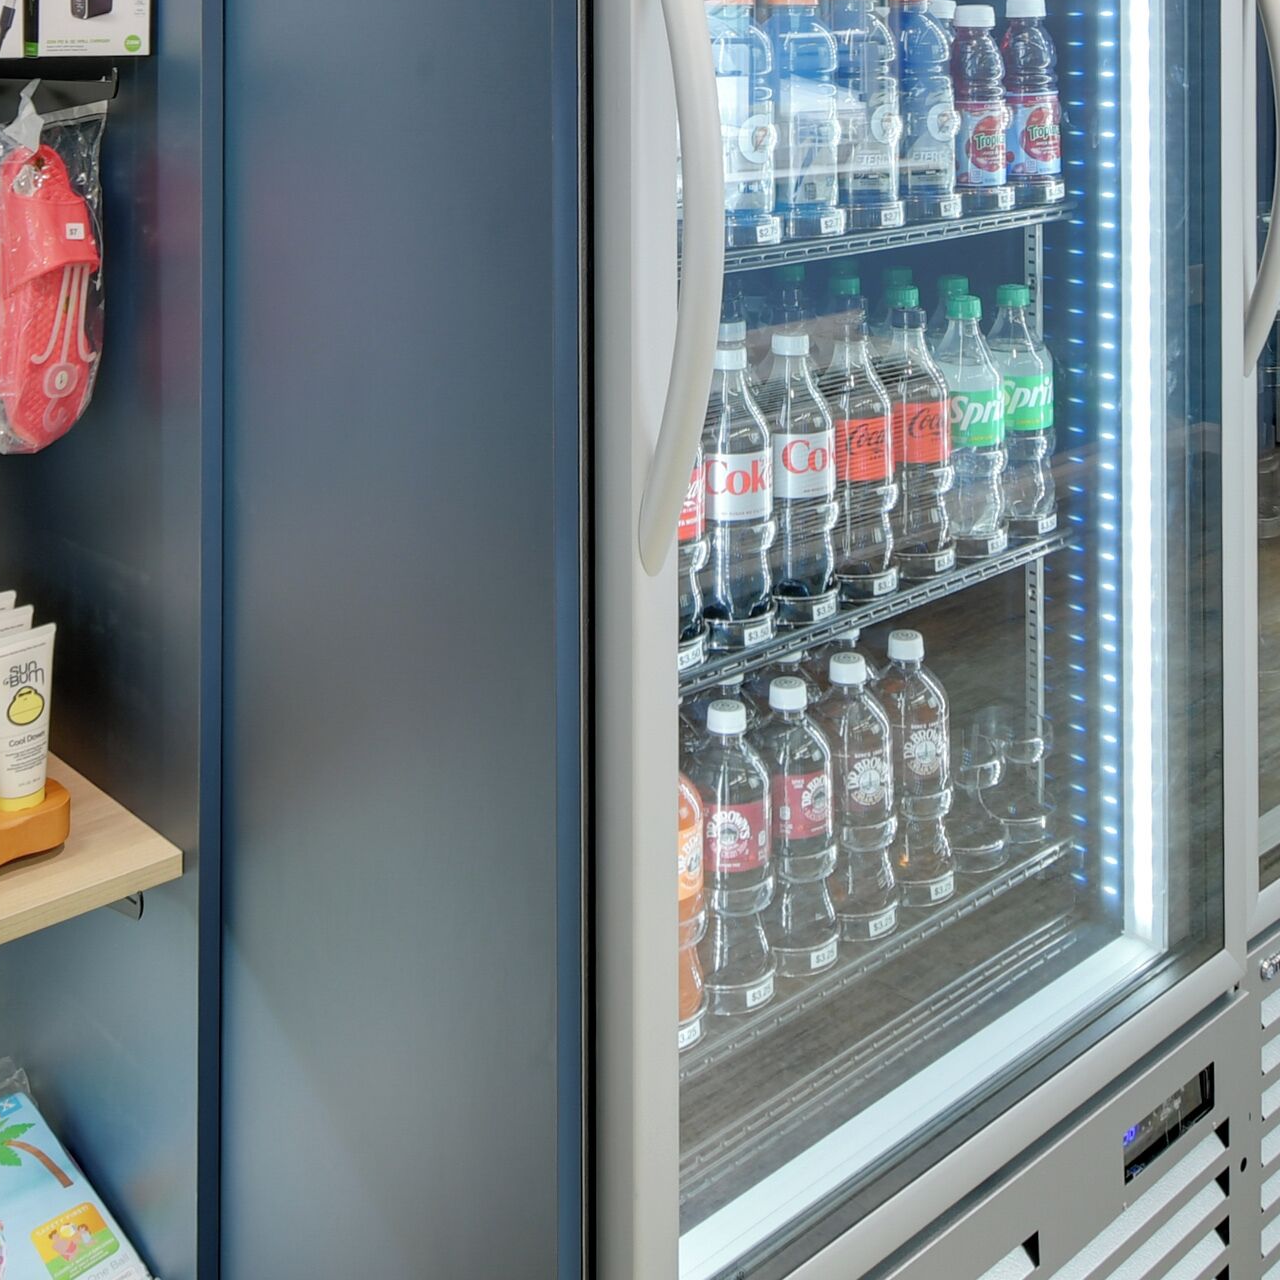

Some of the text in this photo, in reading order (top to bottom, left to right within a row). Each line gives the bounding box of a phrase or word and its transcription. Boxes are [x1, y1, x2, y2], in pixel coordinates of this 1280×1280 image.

[950, 393, 1004, 431] Spri
[748, 628, 770, 641] $3.50
[679, 649, 701, 666] $3.50
[934, 882, 952, 896] $3.25
[874, 916, 893, 932] $3.25
[815, 948, 835, 964] $3.25
[679, 1026, 697, 1043] 3.25
